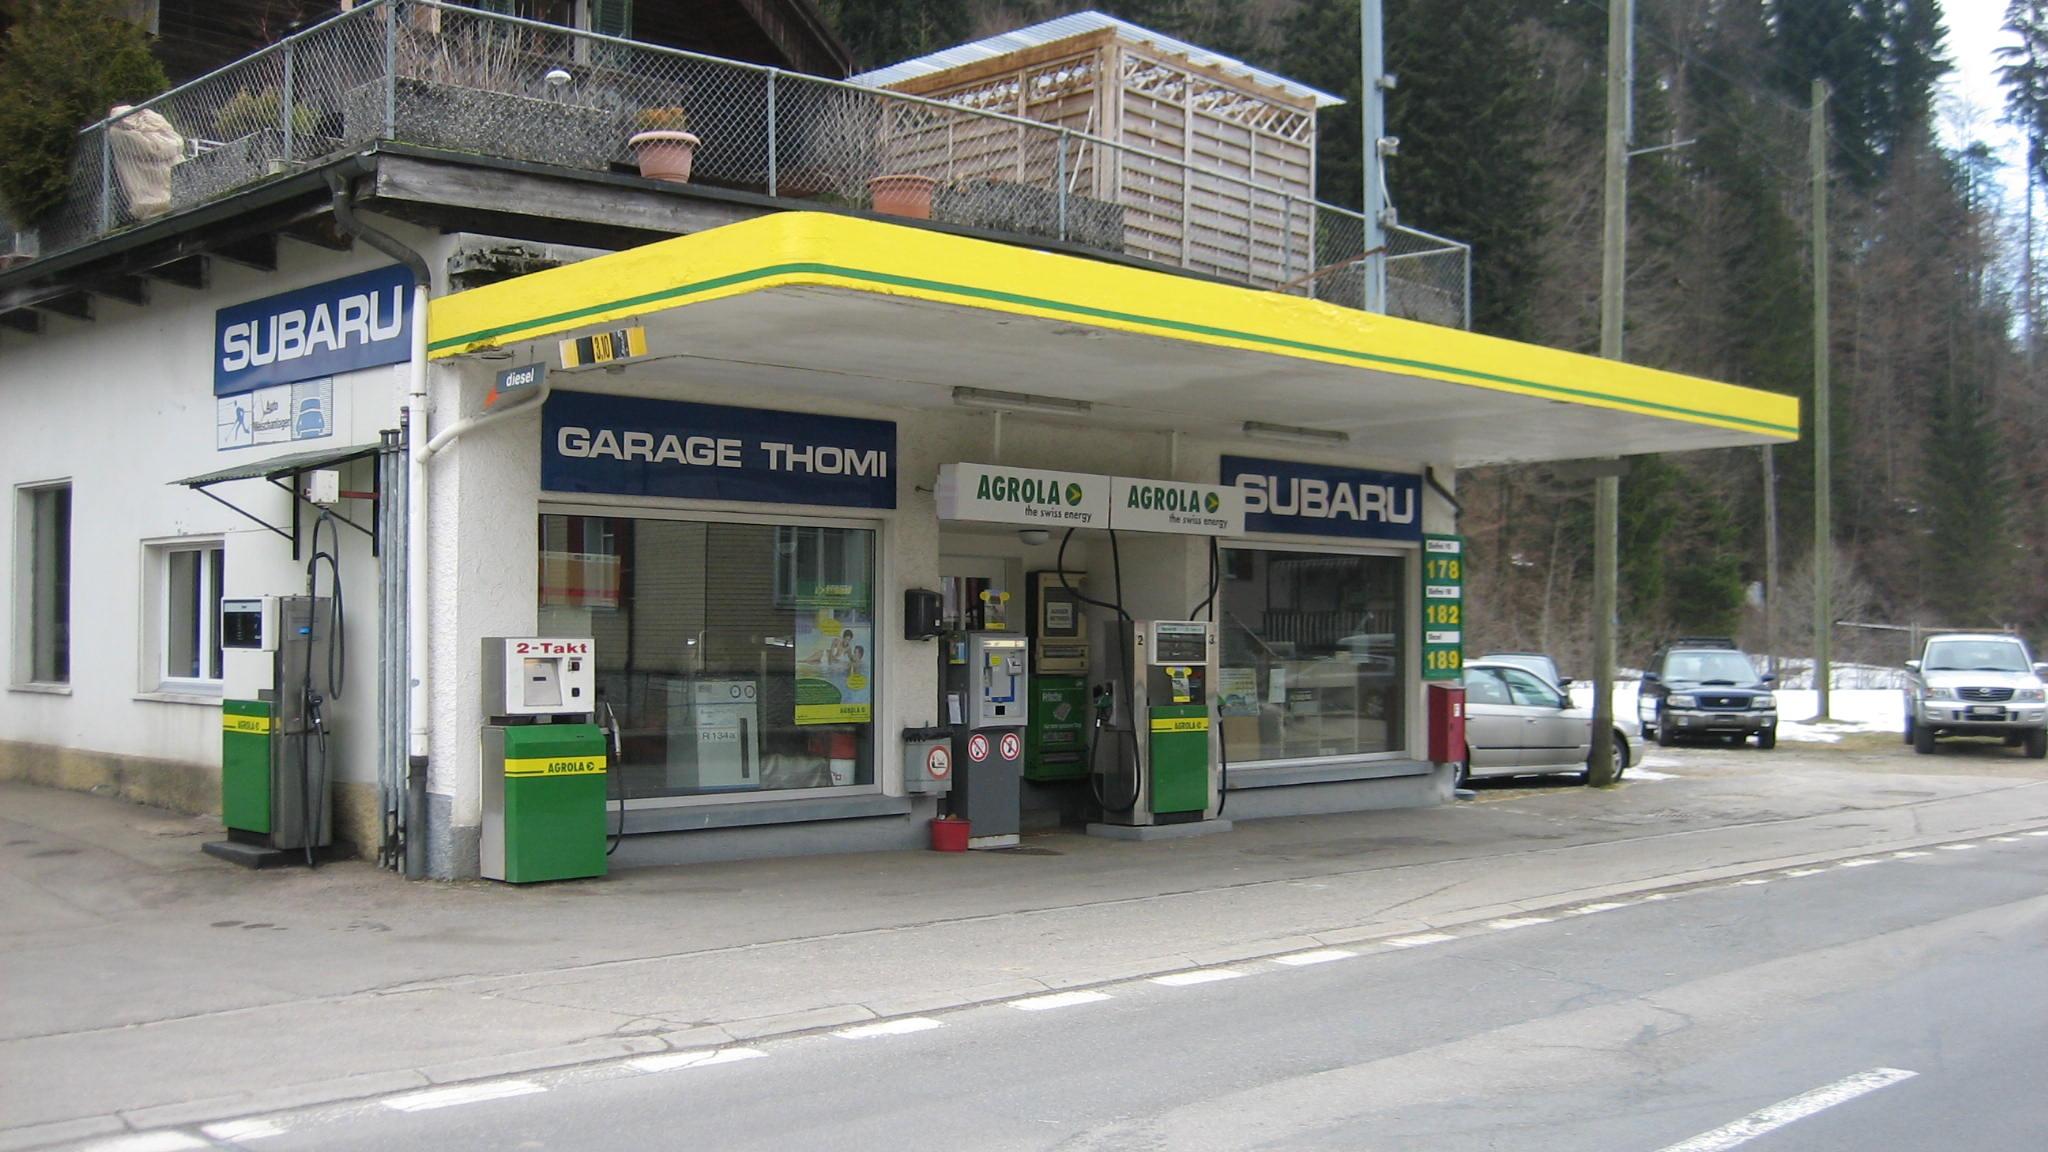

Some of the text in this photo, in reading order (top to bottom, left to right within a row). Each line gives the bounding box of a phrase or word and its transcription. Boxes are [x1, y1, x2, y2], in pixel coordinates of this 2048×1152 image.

[223, 285, 403, 373] SUBARU
[506, 367, 535, 388] diesel
[557, 426, 888, 478] GARAGE THOMI
[976, 474, 1061, 506] AGROLA
[1127, 485, 1200, 513] AGROLA
[1235, 473, 1414, 525] SUBARU
[1025, 505, 1093, 523] the swiss energy
[1204, 518, 1228, 529] energy
[1427, 559, 1460, 580] 178
[1427, 604, 1460, 625] 182
[516, 642, 588, 655] 2-Takt
[1137, 635, 1144, 646] 2
[1427, 650, 1460, 671] 189
[547, 761, 585, 774] AGROLA
